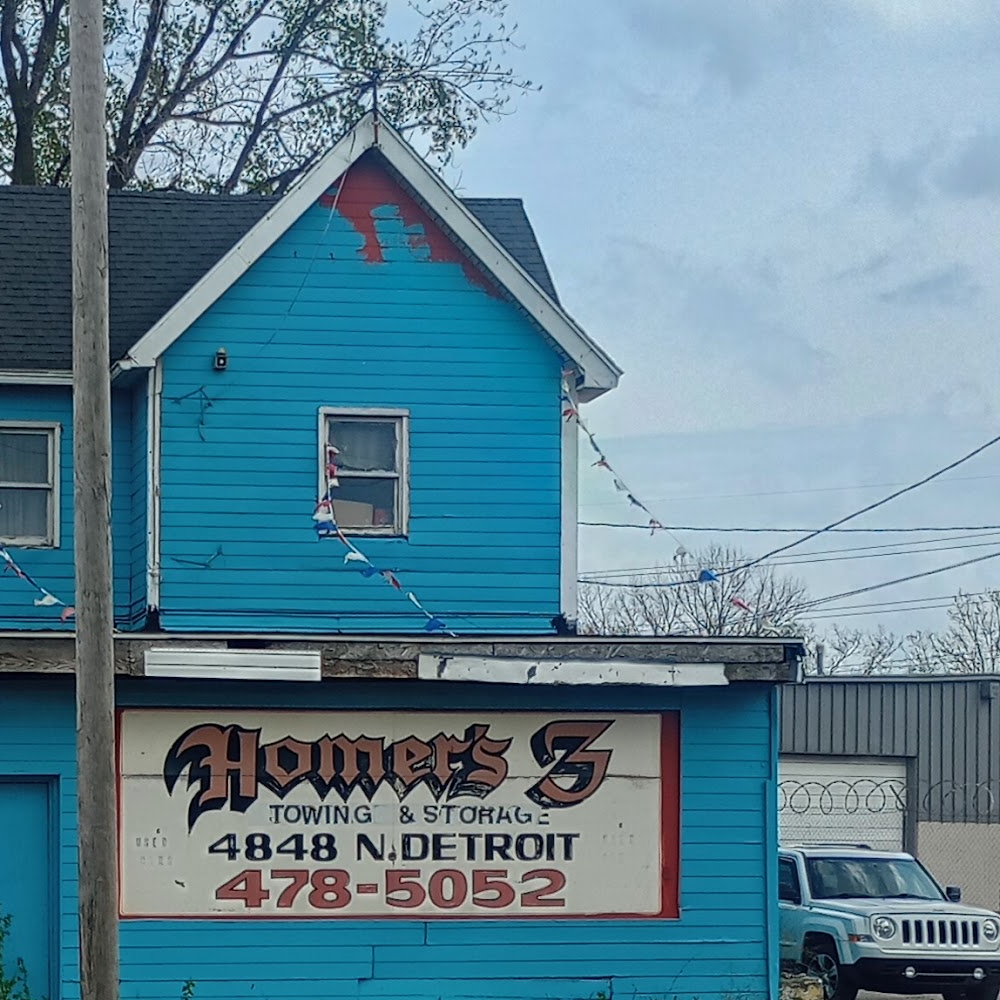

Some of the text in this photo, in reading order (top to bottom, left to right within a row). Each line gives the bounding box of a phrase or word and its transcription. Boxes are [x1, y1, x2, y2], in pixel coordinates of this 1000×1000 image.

[164, 723, 514, 834] Homer's
[269, 805, 372, 825] TOWING
[399, 805, 416, 825] &
[208, 832, 338, 861] 4848
[215, 868, 567, 909] 478-5052
